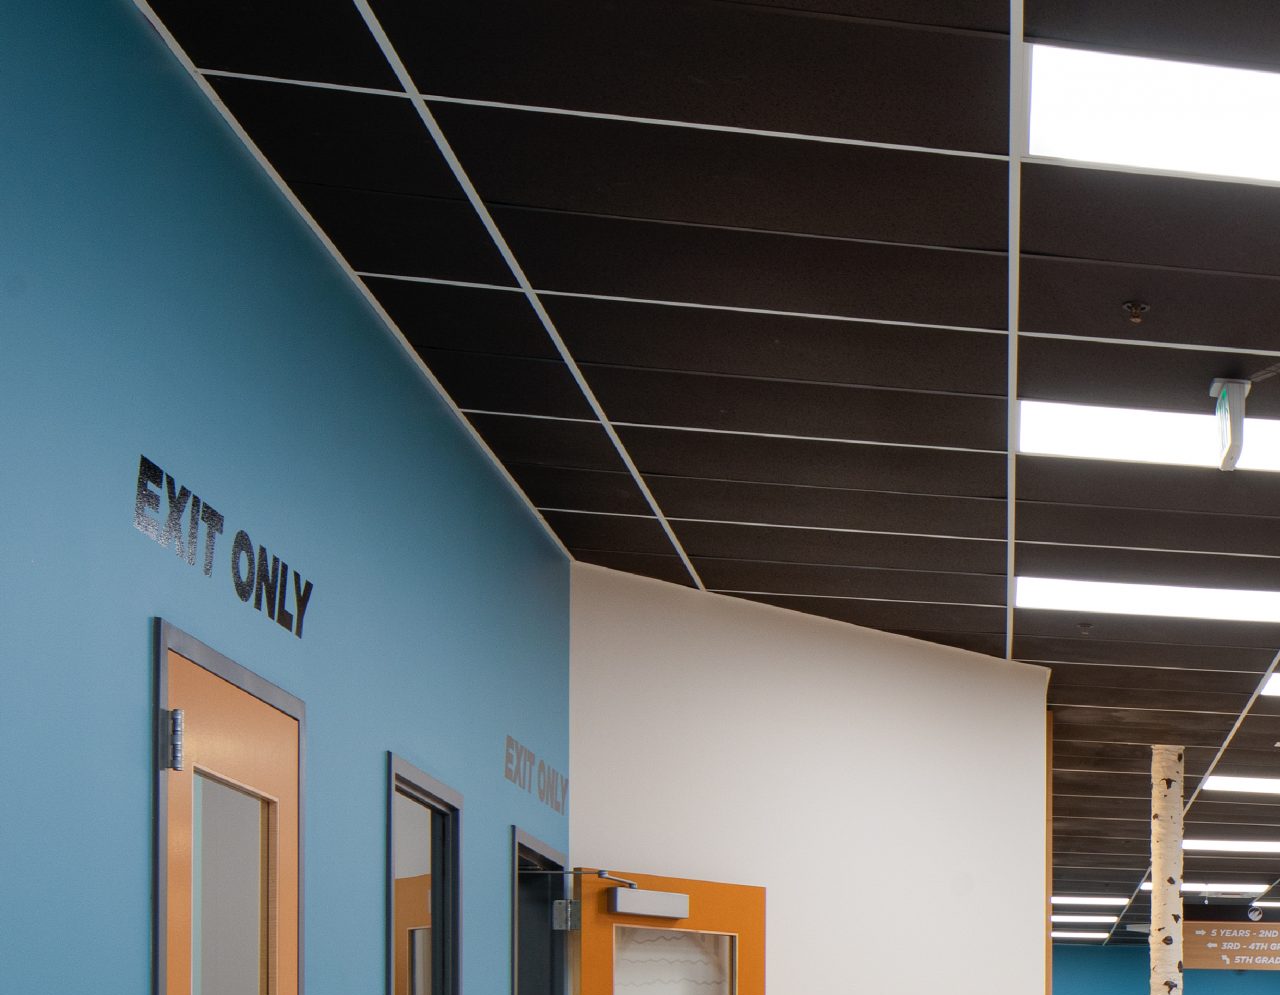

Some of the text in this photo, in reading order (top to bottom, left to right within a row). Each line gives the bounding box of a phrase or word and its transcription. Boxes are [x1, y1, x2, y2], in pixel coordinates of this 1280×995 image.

[133, 453, 314, 639] EXIT ONLY
[504, 735, 569, 816] EXIT ONLY
[1210, 929, 1217, 937] 5
[1220, 929, 1250, 937] YEARS
[1258, 930, 1279, 938] 2ND
[1221, 942, 1241, 950] 3RD
[1248, 942, 1269, 950] 4TH
[1234, 955, 1254, 964] 5TH
